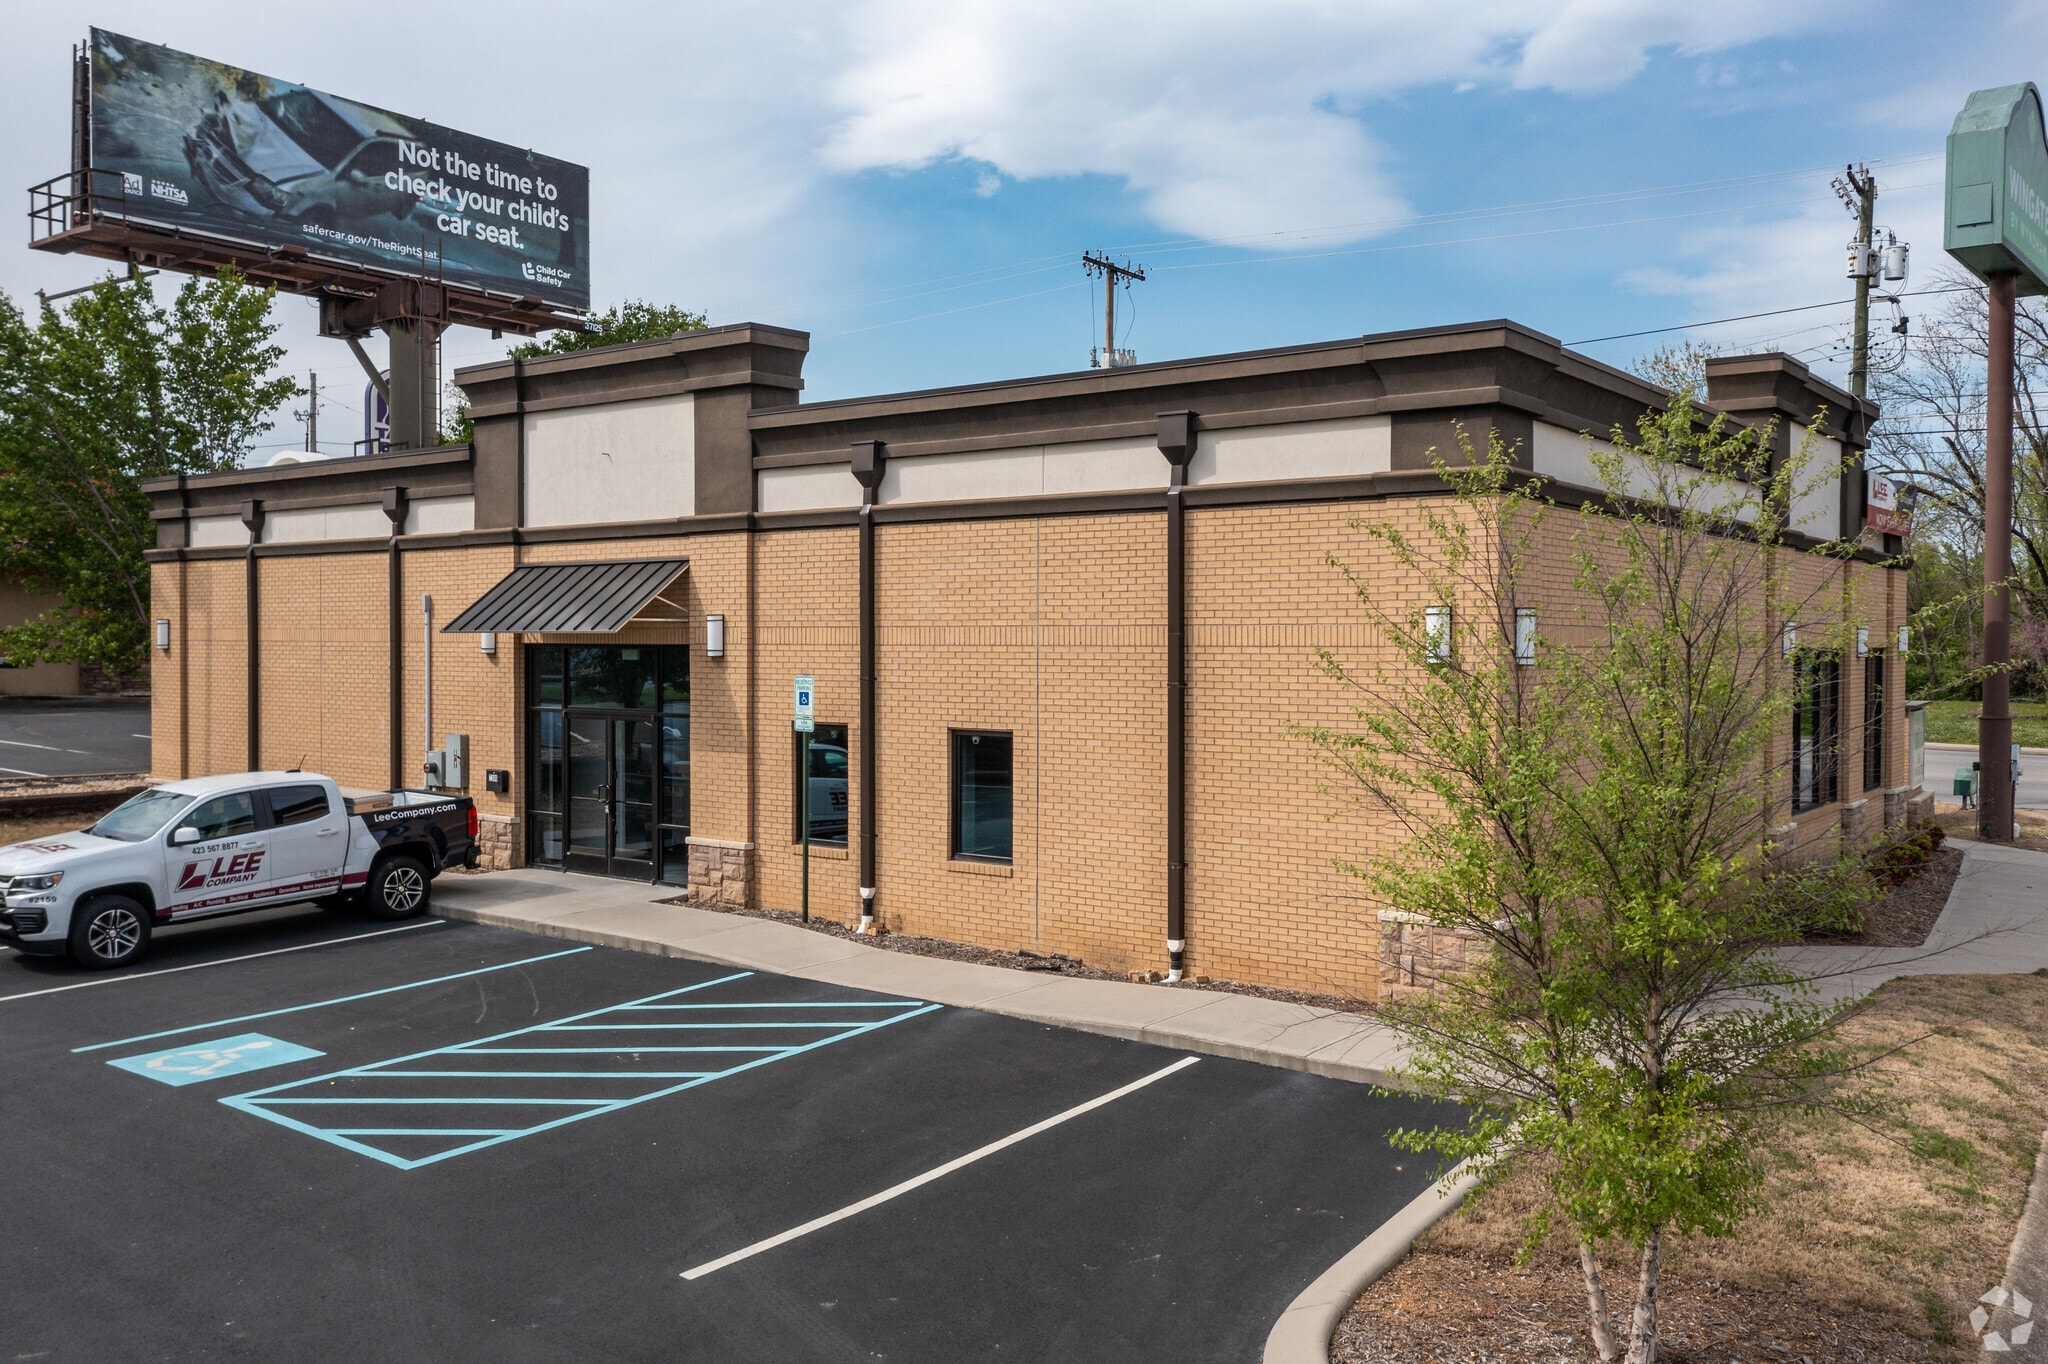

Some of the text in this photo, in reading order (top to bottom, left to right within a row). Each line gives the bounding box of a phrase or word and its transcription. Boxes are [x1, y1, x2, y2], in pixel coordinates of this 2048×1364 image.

[398, 139, 558, 201] Not the time to
[151, 183, 188, 200] NHTSA
[384, 168, 570, 232] check your child's
[436, 213, 525, 249] car seat.
[302, 224, 439, 260] safercar.gov/TheRightSeat
[536, 265, 571, 279] Child Car
[536, 274, 562, 288] Safety
[374, 802, 457, 823] LeeCompany.com
[192, 846, 205, 855] 423
[210, 851, 266, 878] LEE
[206, 872, 258, 887] COMPANY
[29, 895, 57, 904] #2159
